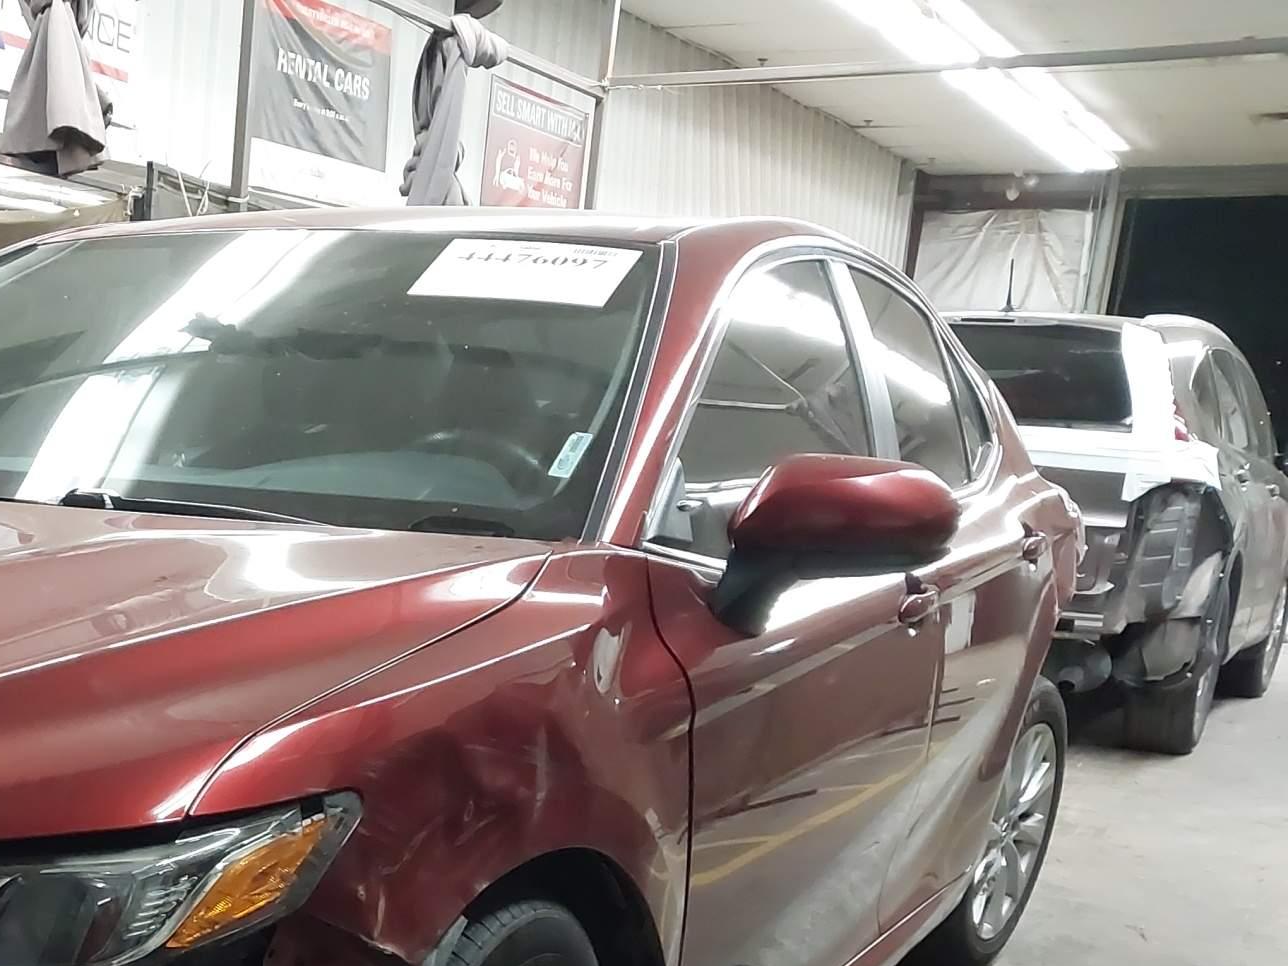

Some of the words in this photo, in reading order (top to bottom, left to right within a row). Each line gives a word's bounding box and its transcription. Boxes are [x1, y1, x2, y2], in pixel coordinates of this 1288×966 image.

[277, 47, 331, 89] RENTAL
[333, 68, 370, 101] CARS
[496, 90, 516, 117] SELL
[517, 99, 547, 128] SMART
[547, 109, 569, 137] WITH
[457, 251, 608, 270] 44476097
